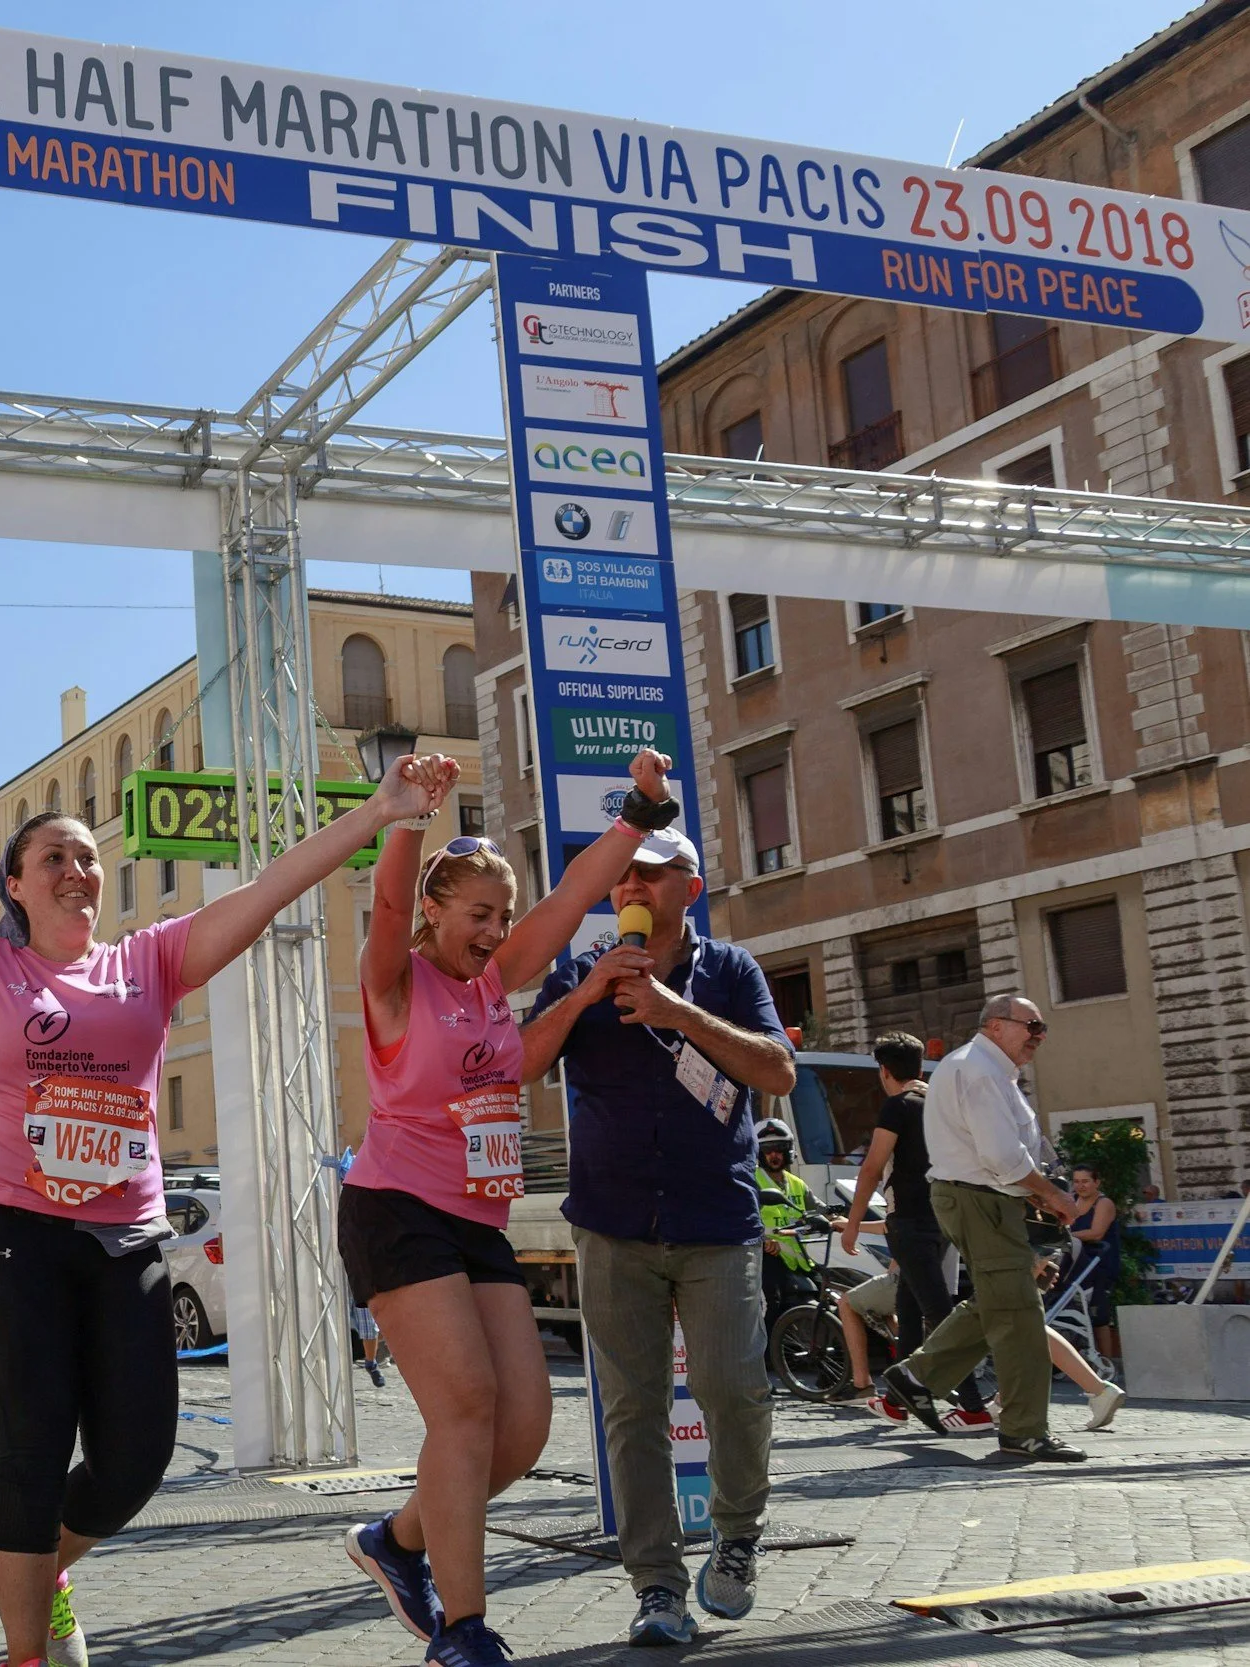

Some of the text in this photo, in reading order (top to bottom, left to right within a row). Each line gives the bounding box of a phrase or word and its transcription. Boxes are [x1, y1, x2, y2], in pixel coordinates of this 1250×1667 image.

[8, 135, 236, 205] MARATHON
[26, 48, 194, 133] HALF
[220, 75, 572, 188] MARATHON
[593, 128, 698, 204] VIA
[715, 146, 886, 230] PACIS
[902, 174, 1195, 271] 23.09.2018
[308, 169, 818, 284] FINISH
[549, 282, 601, 301] PARTNERS
[882, 249, 1143, 320] RUN FOR PEACE
[549, 324, 633, 341] GTECHNOLOGY
[534, 442, 646, 478] acea
[577, 561, 655, 577] SOS VILLAGGI
[578, 574, 649, 589] DEI BAMBINI
[579, 589, 614, 600] ITALIA
[558, 681, 664, 702] OFFICIAL SUPPLIERS
[570, 717, 656, 741] ULIVETO
[26, 1049, 94, 1061] Fondazione
[27, 1060, 130, 1072] Umberto Veronesi
[54, 1086, 139, 1108] ROME HALF MARATHO
[54, 1099, 69, 1109] VIA
[71, 1100, 98, 1113] PACIS
[55, 1122, 121, 1167] W548
[45, 1180, 102, 1206] ace
[485, 1177, 525, 1198] ace
